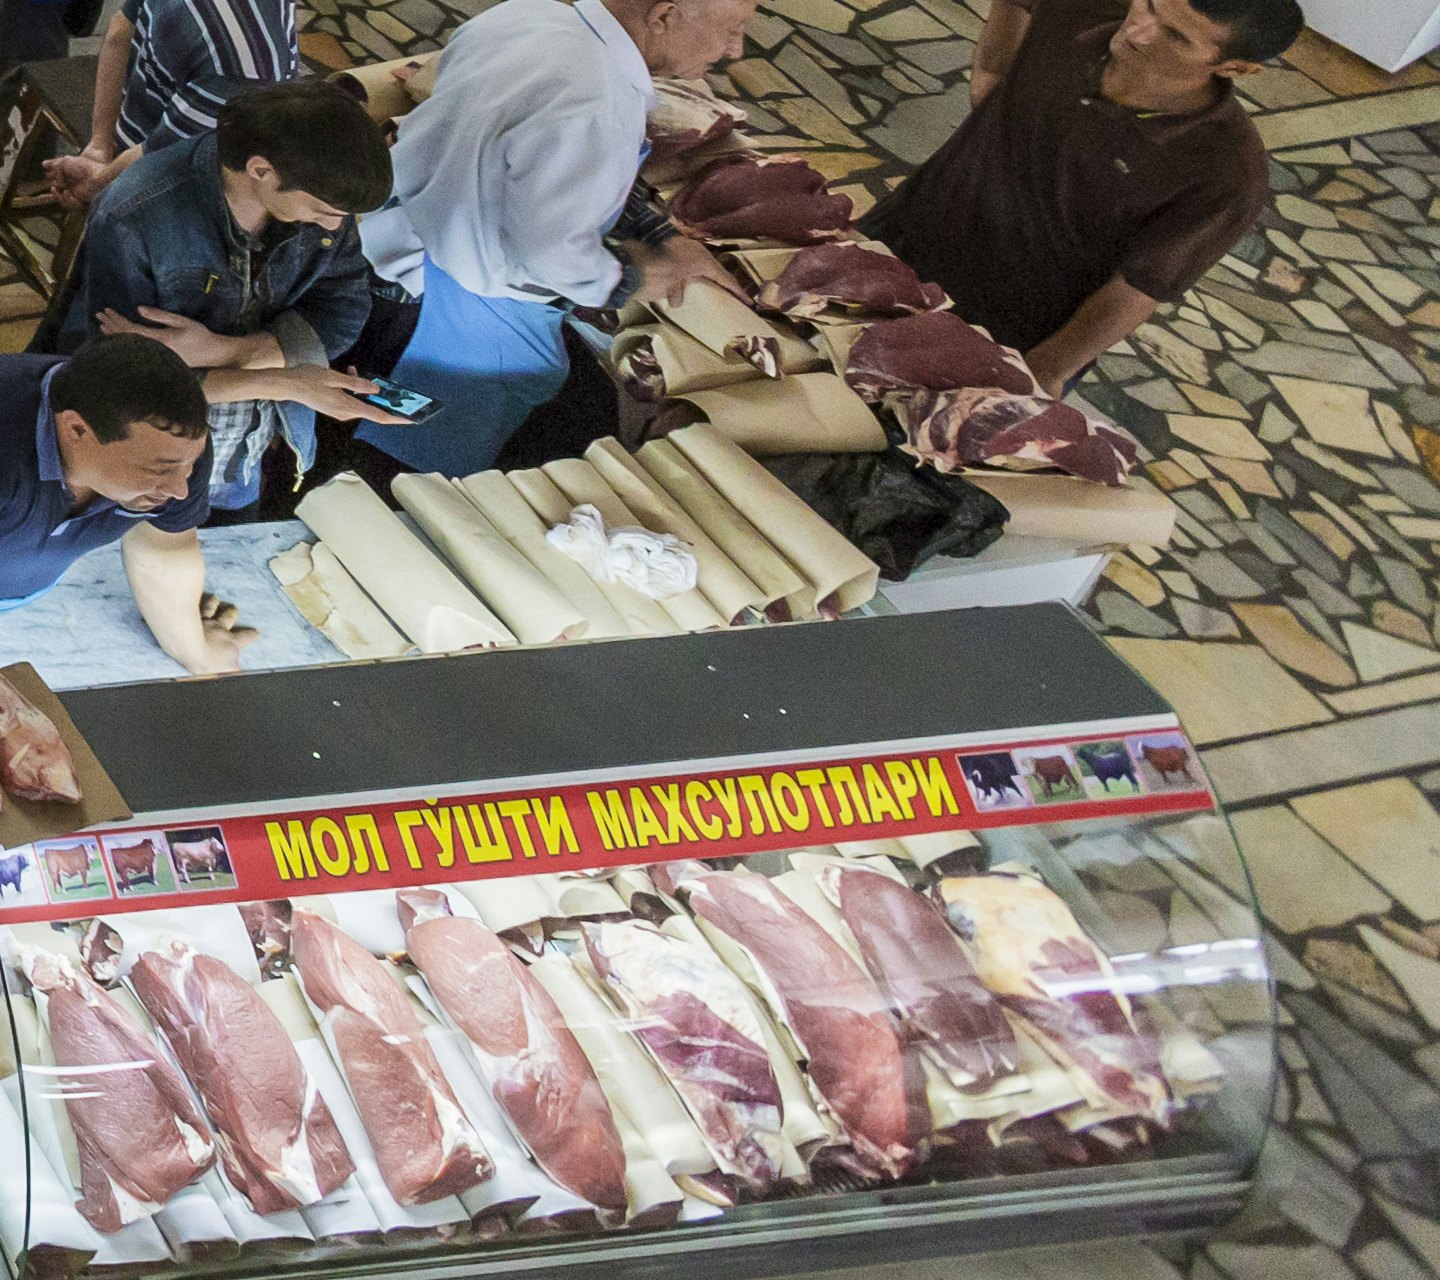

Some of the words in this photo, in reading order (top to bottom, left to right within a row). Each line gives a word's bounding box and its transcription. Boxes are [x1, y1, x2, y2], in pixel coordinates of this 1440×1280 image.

[263, 813, 391, 883] МОЛ
[392, 796, 581, 871] ГЎШТИ
[587, 756, 960, 851] МАХСУЛОТЛАРИ
